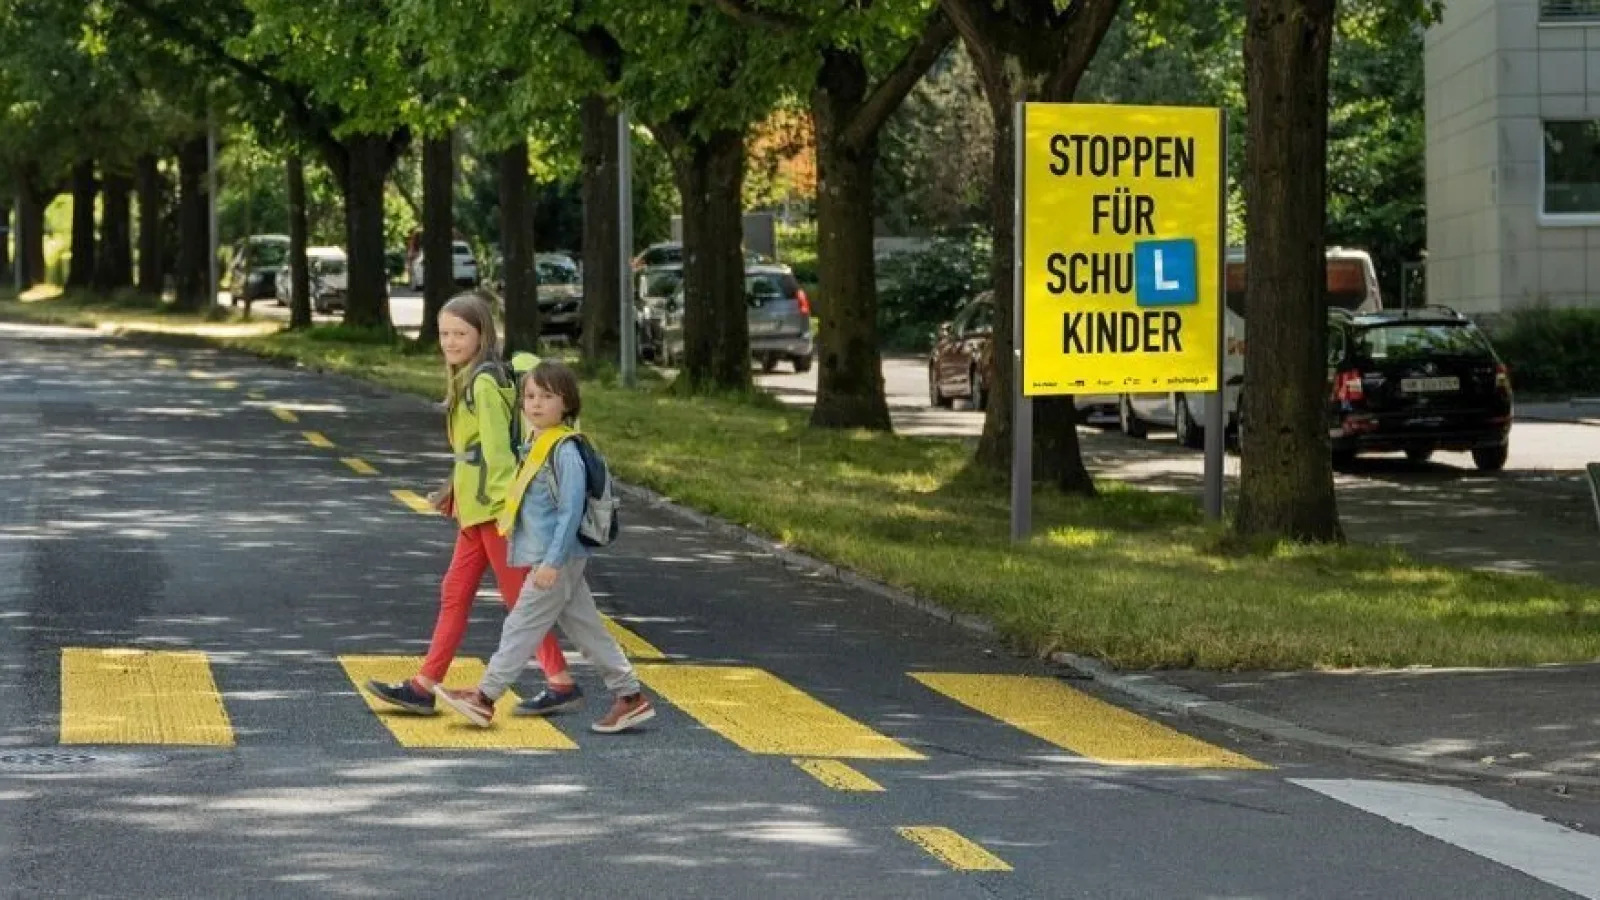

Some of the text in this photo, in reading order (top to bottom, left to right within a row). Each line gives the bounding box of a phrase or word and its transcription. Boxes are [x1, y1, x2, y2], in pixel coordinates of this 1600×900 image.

[1049, 134, 1194, 178] STOPPEN
[1092, 187, 1156, 236] FÜR
[1063, 311, 1183, 354] KINDER
